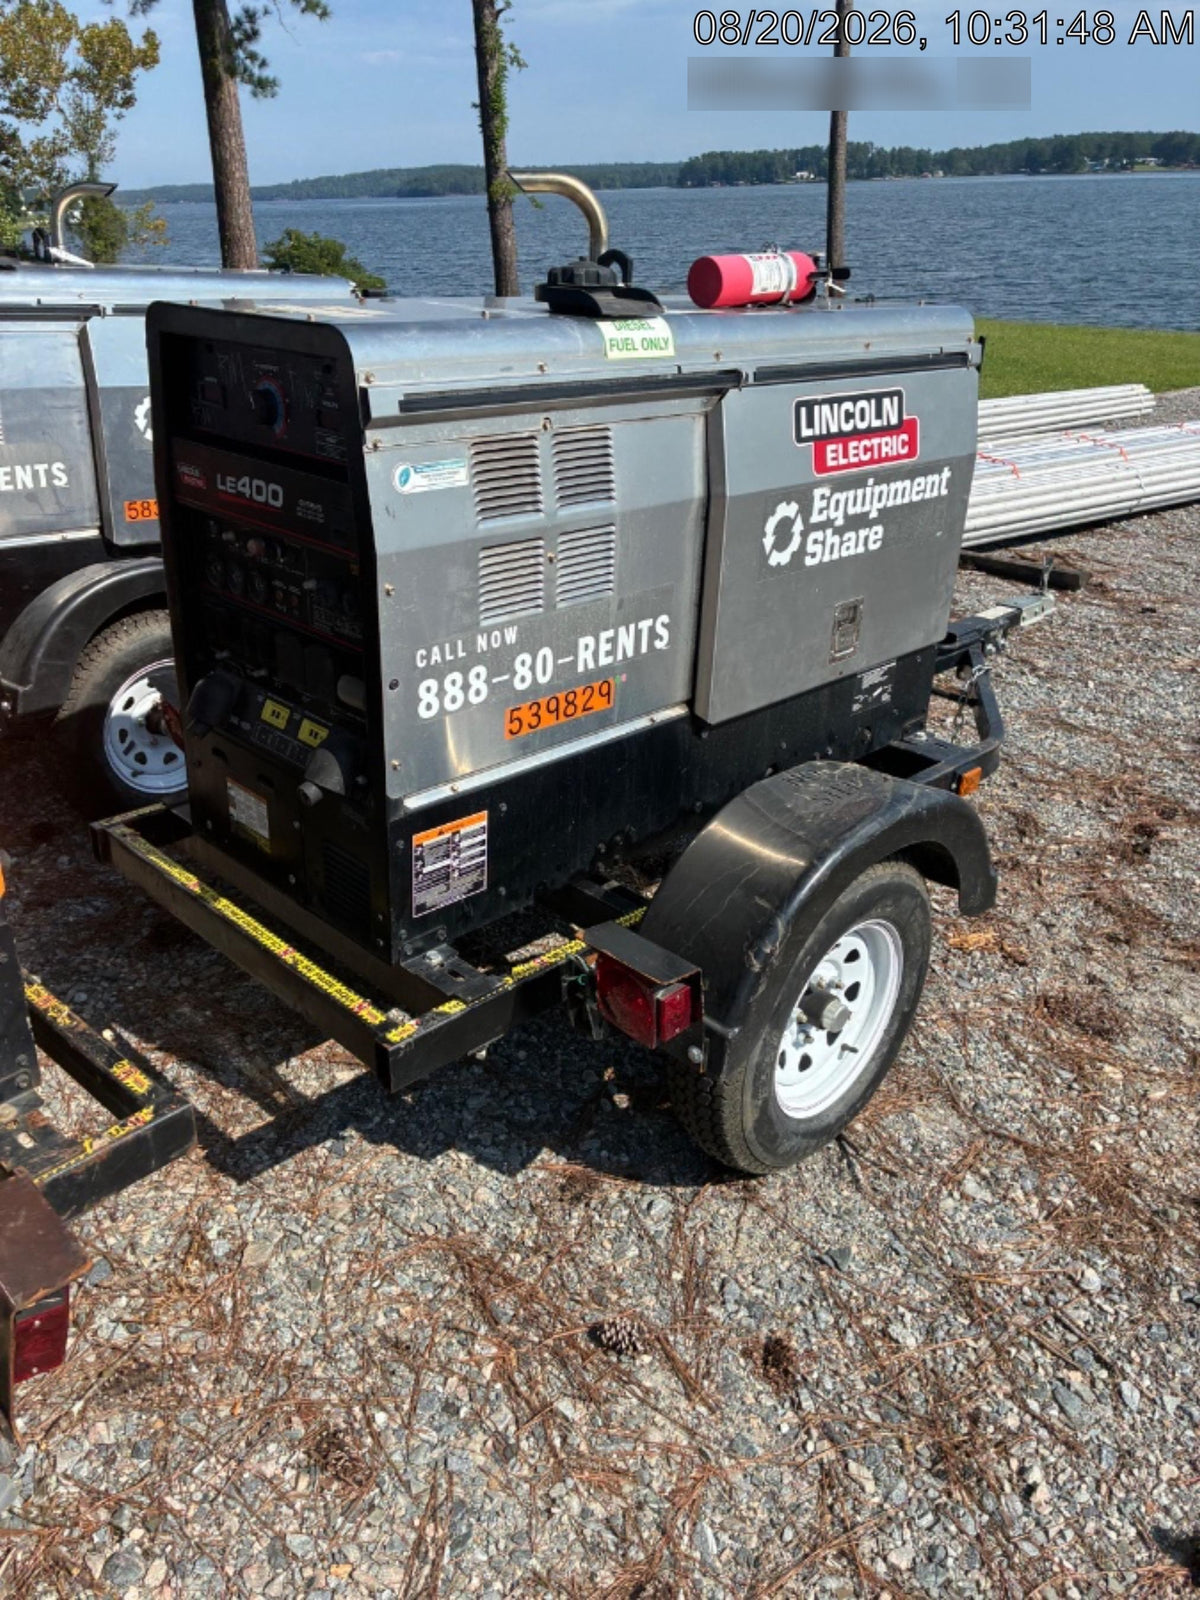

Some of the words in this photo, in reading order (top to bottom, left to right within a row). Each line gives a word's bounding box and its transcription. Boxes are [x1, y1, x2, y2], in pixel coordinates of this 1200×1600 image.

[608, 337, 638, 352] FUEL
[641, 337, 670, 352] ONLY
[800, 396, 899, 438] LINCOLN
[825, 433, 910, 467] ELECTRIC
[216, 473, 284, 508] LE400
[809, 465, 952, 527] Equipment
[804, 524, 885, 567] Share
[415, 639, 467, 668] CALL
[476, 625, 519, 653] NOW
[507, 680, 613, 736] 539829
